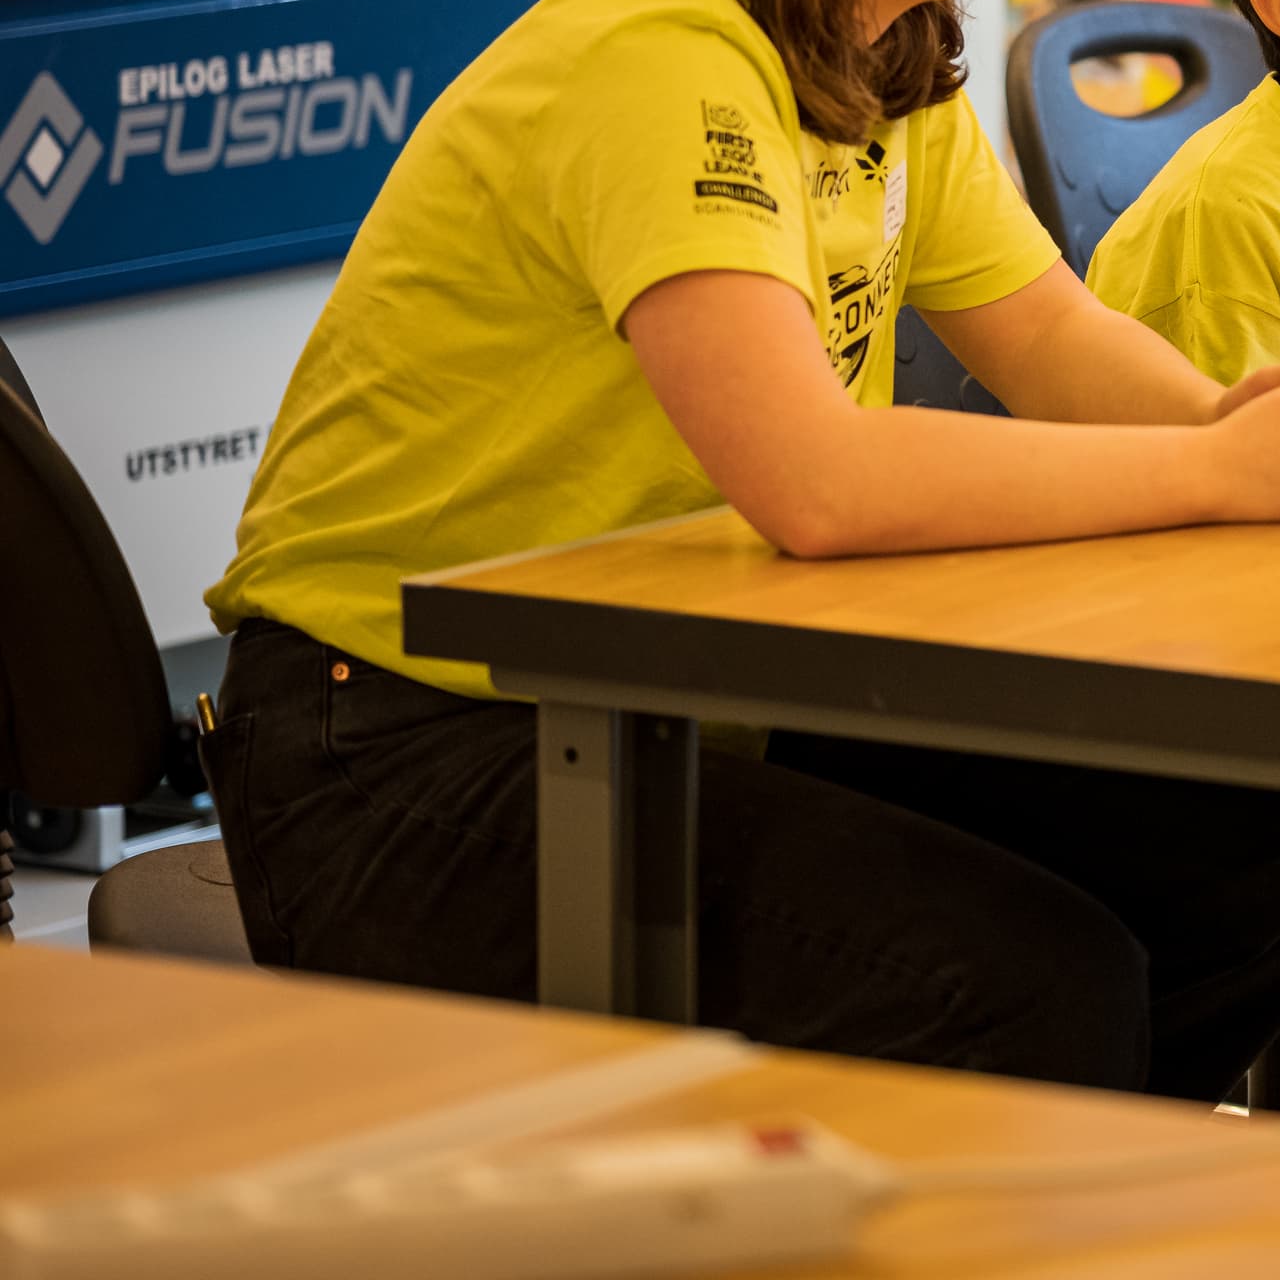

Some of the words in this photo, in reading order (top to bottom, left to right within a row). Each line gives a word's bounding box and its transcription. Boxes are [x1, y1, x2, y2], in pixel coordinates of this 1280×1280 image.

[119, 57, 228, 105] EPILOG
[238, 41, 334, 89] LASER
[108, 68, 413, 185] FUSION
[126, 426, 260, 483] UTSTYRET
